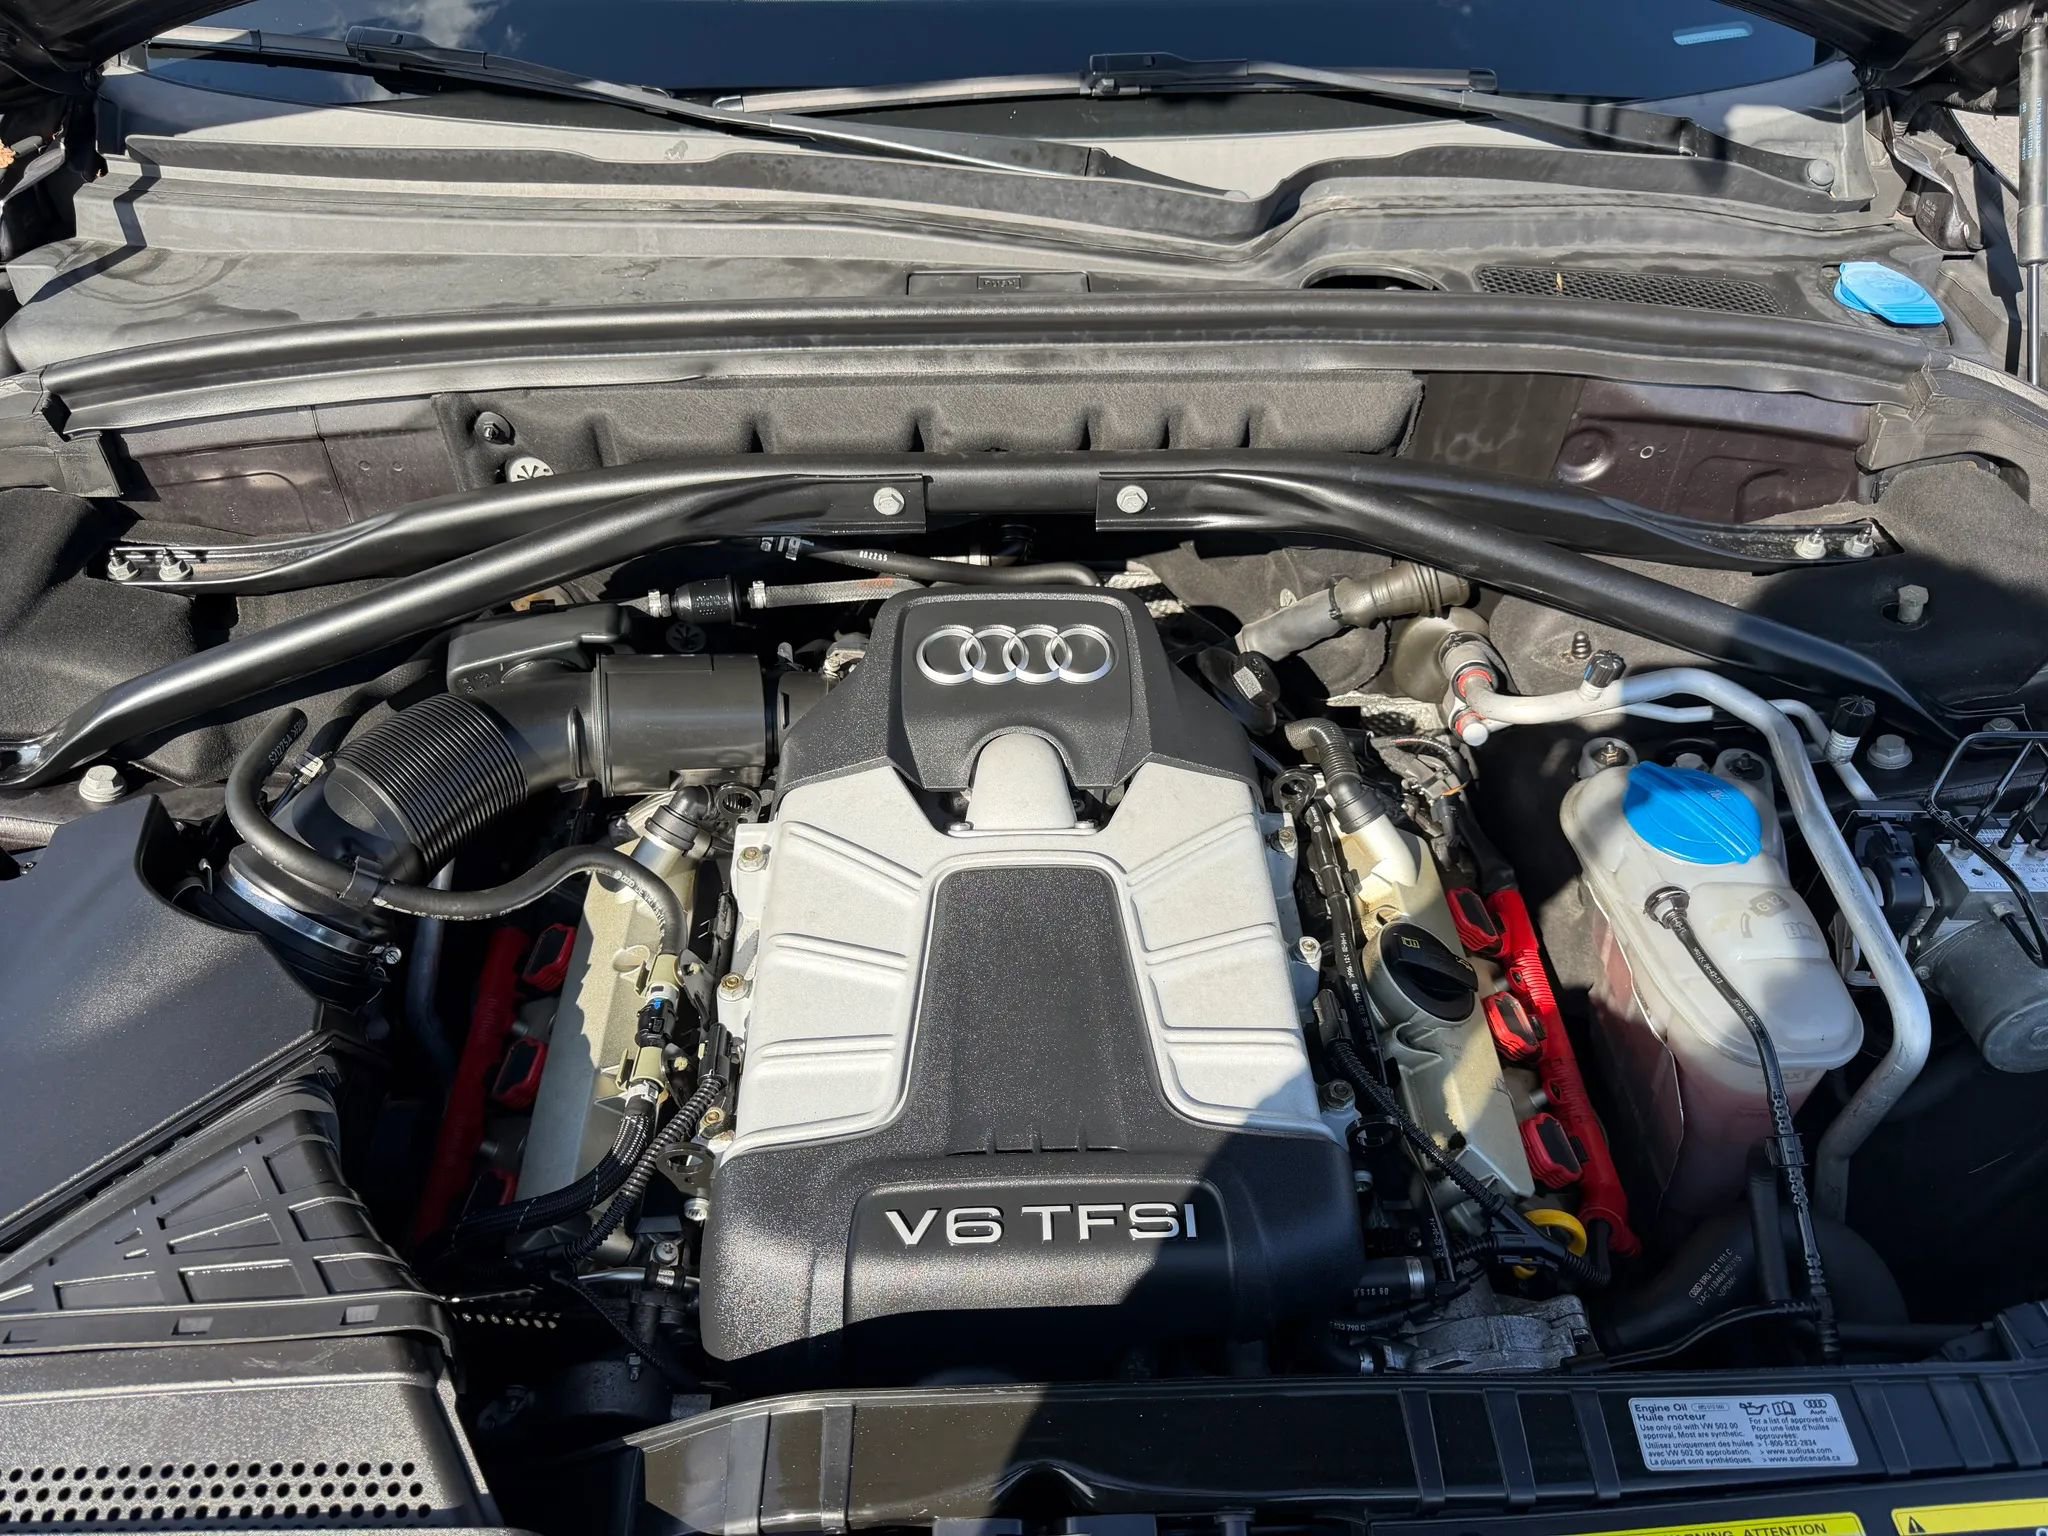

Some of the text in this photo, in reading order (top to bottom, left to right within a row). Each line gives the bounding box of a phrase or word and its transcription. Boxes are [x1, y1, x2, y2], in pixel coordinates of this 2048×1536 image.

[885, 1202, 1198, 1248] V6 TFSI
[1635, 1404, 1670, 1413] Engine
[1673, 1403, 1687, 1411] Oil
[1637, 1414, 1663, 1422] Huile
[1791, 1416, 1823, 1424] approved
[1673, 1441, 1716, 1449] uniquement
[1660, 1458, 1686, 1466] plupart
[1743, 1523, 1826, 1536] ATTENTION
